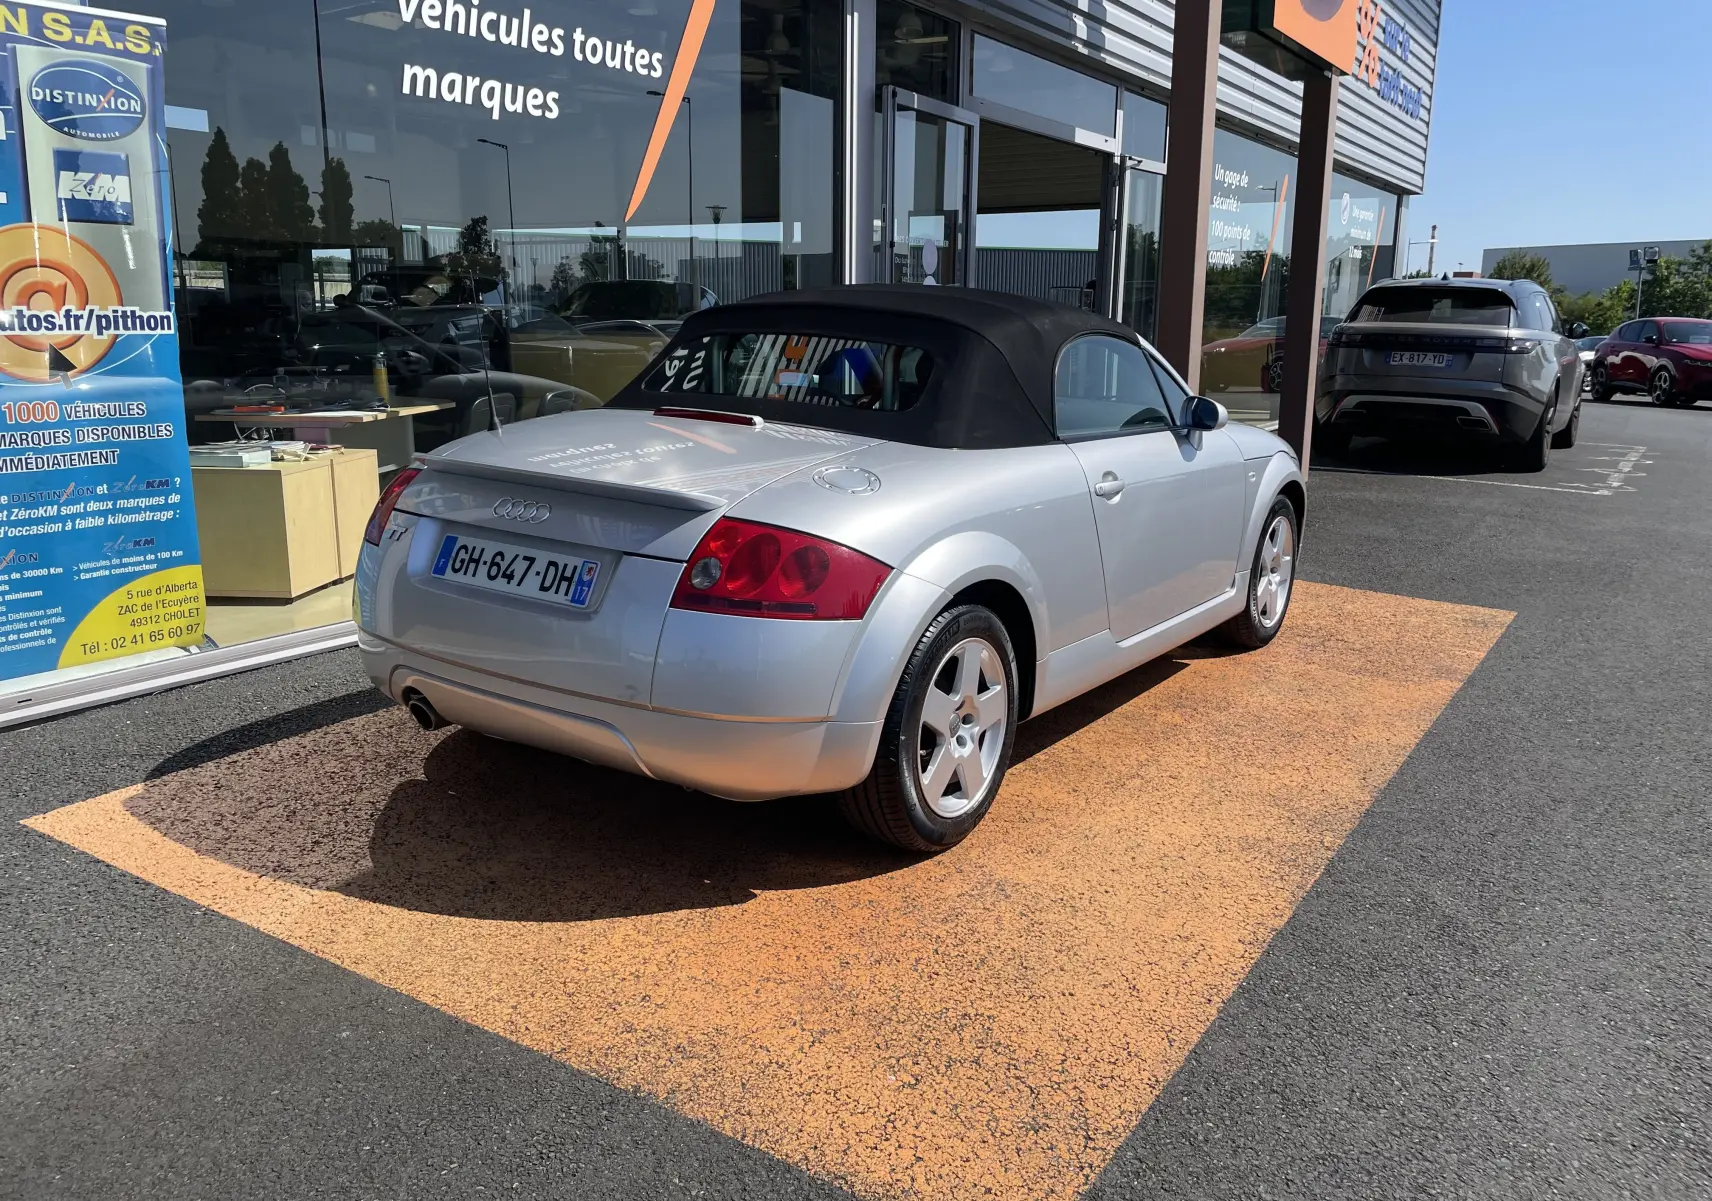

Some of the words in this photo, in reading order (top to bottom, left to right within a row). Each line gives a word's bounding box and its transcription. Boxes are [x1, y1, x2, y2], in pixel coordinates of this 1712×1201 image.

[42, 12, 160, 56] S.A.S.
[573, 27, 663, 78] toutes
[32, 87, 141, 113] DISTINXION
[402, 63, 560, 120] marques
[63, 127, 120, 138] AUTOMOBILE
[1214, 164, 1224, 182] Un
[1224, 171, 1241, 189] gage
[1241, 170, 1249, 188] de
[1211, 220, 1224, 237] 100
[1223, 222, 1243, 241] points
[1242, 224, 1251, 241] de
[1208, 248, 1235, 265] contrôle
[2, 401, 59, 424] 1000
[64, 400, 147, 420] VÉHICULES
[76, 424, 174, 443] DISPONIBLES
[11, 483, 94, 503] DISTINXION
[96, 484, 108, 494] et
[175, 477, 181, 487] ?
[10, 505, 58, 520] ZéroKM
[60, 502, 85, 515] sont
[87, 500, 114, 512] deux
[116, 496, 165, 508] marques
[168, 493, 181, 503] de
[65, 519, 72, 531] à
[75, 516, 105, 529] faible
[107, 509, 174, 525] kilomètrage
[79, 560, 110, 570] Véhicules
[122, 555, 144, 563] moins
[80, 569, 109, 580] Garantie
[111, 563, 158, 575] constructeur
[438, 558, 446, 568] F
[451, 544, 578, 596] GH-647-DH
[22, 568, 48, 578] 30000
[50, 567, 63, 575] Km
[5, 590, 43, 601] minimum
[127, 591, 133, 599] 5
[136, 588, 152, 598] rue
[155, 580, 198, 595] d'Alberta
[576, 585, 590, 601] 17
[8, 609, 44, 621] Distinxion
[46, 606, 62, 615] sont
[118, 604, 138, 615] ZAC
[141, 602, 153, 611] de
[156, 595, 199, 610] l'Ecuyère
[39, 616, 66, 625] vérifiés
[130, 615, 160, 628] 49312
[163, 607, 201, 622] CHOLET
[20, 628, 53, 639] contrôle
[47, 637, 57, 645] de
[81, 642, 100, 656] Tél
[111, 636, 127, 650] 02
[131, 633, 144, 645] 41
[149, 629, 164, 642] 65
[168, 626, 183, 639] 60
[186, 623, 201, 635] 97
